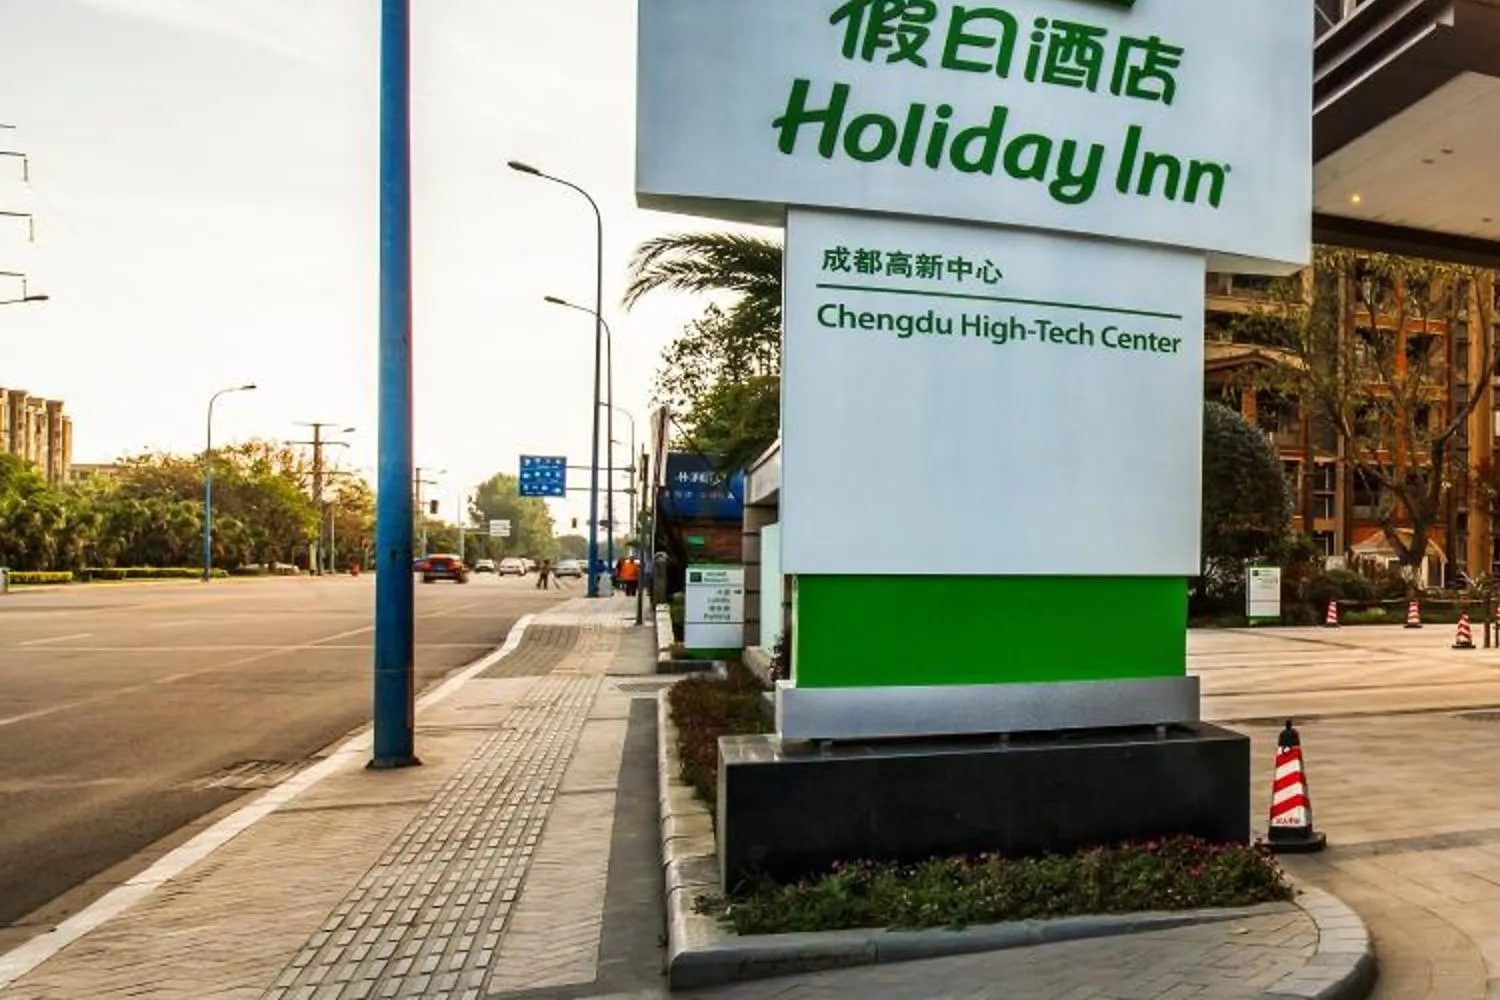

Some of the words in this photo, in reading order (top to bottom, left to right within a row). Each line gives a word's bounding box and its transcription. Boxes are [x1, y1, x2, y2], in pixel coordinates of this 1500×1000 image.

[771, 77, 1105, 205] Holiday
[1115, 124, 1232, 209] Inn
[821, 245, 1004, 285] 成都高新中心
[816, 303, 954, 339] Chengdu
[961, 313, 1095, 348] High-Tech
[1100, 325, 1182, 354] Center
